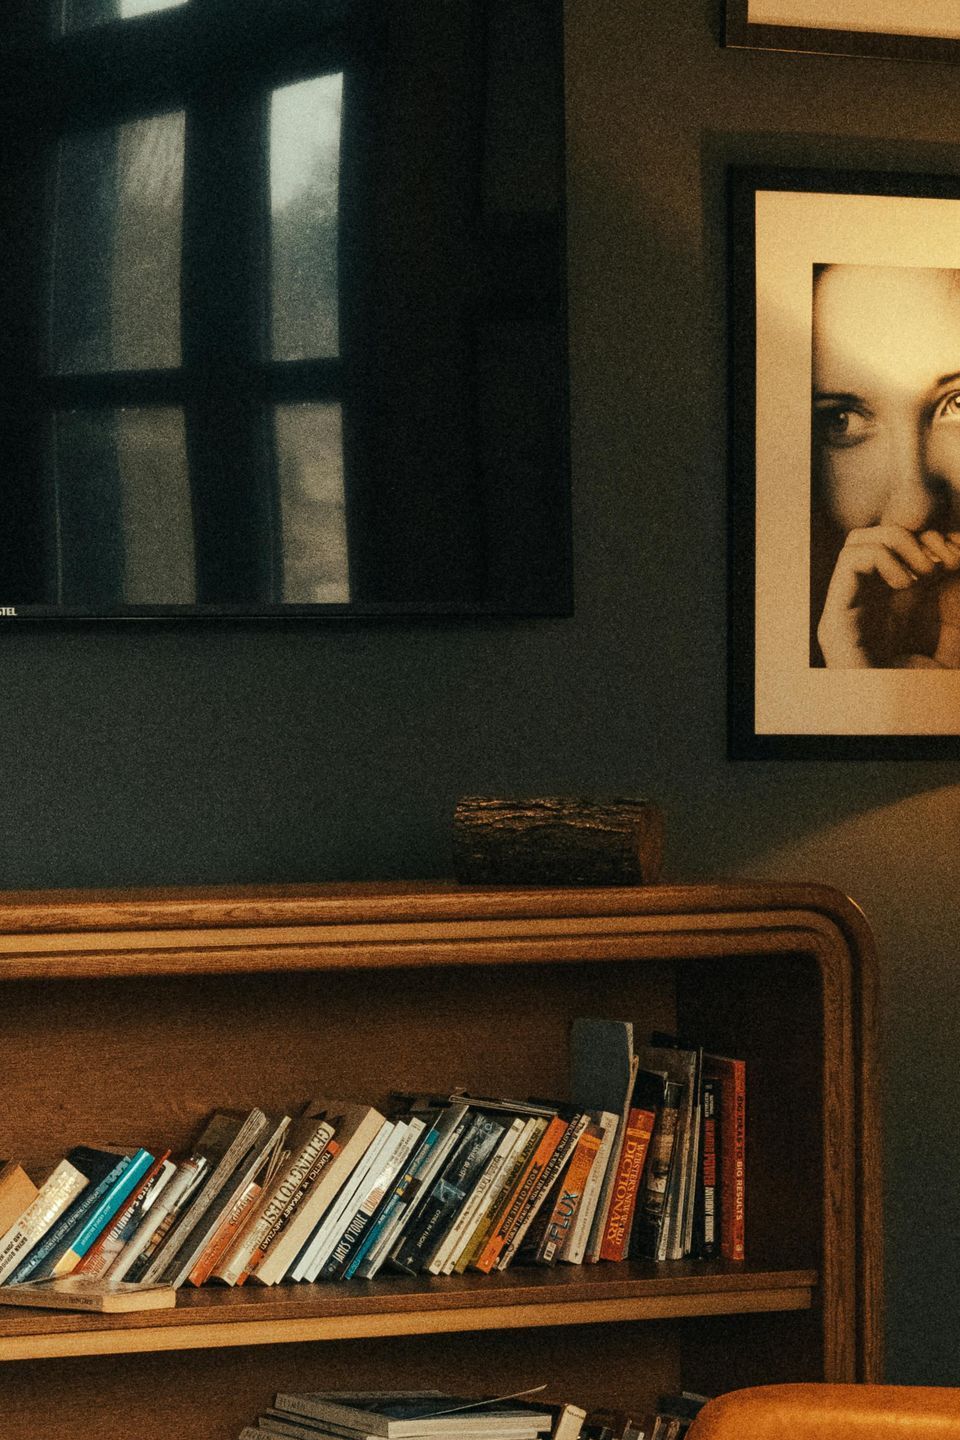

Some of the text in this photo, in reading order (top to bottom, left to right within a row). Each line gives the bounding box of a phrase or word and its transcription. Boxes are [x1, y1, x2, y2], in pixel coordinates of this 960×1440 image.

[519, 1127, 543, 1160] INSTANT
[556, 1112, 581, 1151] FORECASTING
[288, 1125, 331, 1181] GETTING
[547, 1151, 559, 1168] YOUR
[523, 1167, 539, 1190] BOOK
[540, 1166, 551, 1179] LIFE
[703, 1153, 715, 1185] POWER
[277, 1177, 299, 1198] TO
[528, 1178, 544, 1201] TRENDS
[605, 1139, 637, 1244] DICTIONARY
[614, 1142, 645, 1245] WEBSTER'S NEW WRLD
[704, 1186, 714, 1215] ANTHONY
[282, 1190, 303, 1217] REKABET
[429, 1208, 441, 1224] CITIES
[485, 1186, 509, 1220] LESSONS
[510, 1199, 522, 1216] THE
[544, 1188, 579, 1244] FLUX
[106, 1206, 135, 1242] HAMILTON
[259, 1218, 284, 1251] MEVZUATI
[331, 1239, 352, 1263] JAMES
[343, 1213, 368, 1243] O'TOOLE
[415, 1230, 428, 1247] FLIGHT
[2, 1241, 15, 1255] JOHN
